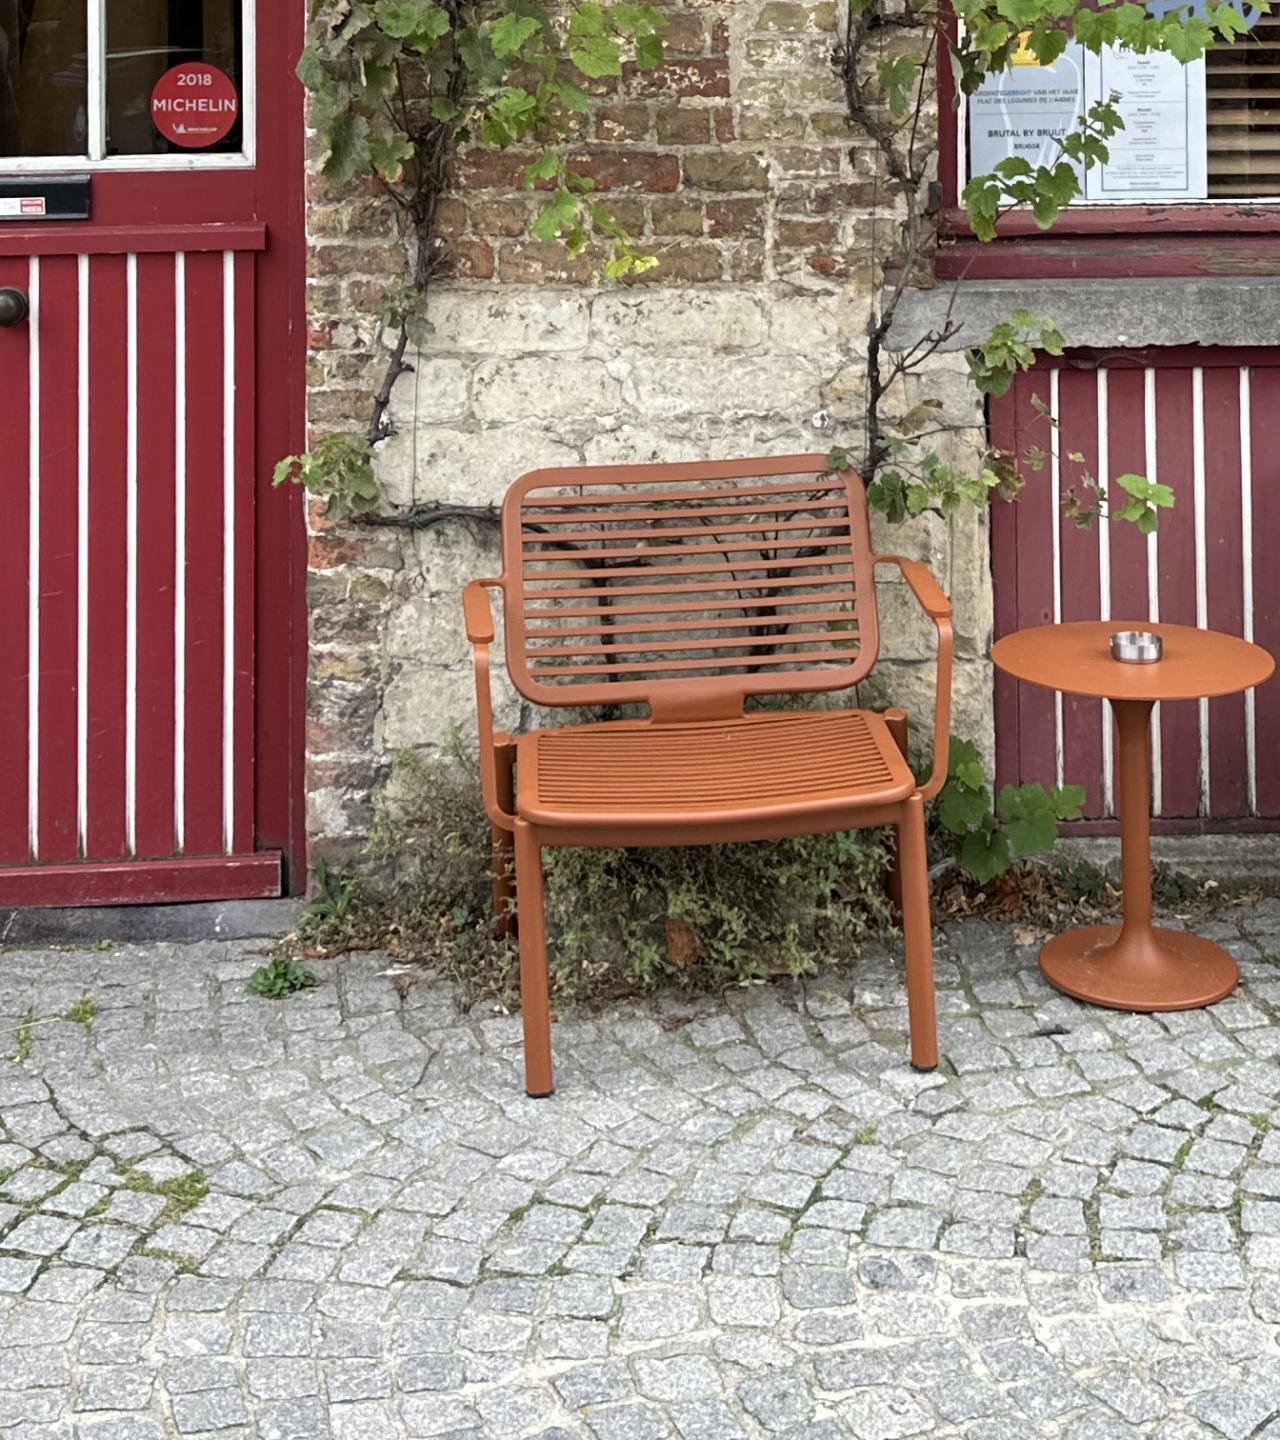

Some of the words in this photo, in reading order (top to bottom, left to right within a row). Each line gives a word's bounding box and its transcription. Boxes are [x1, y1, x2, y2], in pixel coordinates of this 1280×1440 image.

[176, 73, 212, 86] 2018
[153, 98, 236, 112] MICHELIN
[988, 129, 1021, 138] BRUTAL
[1023, 129, 1035, 137] BY
[1037, 128, 1066, 137] BRUUT
